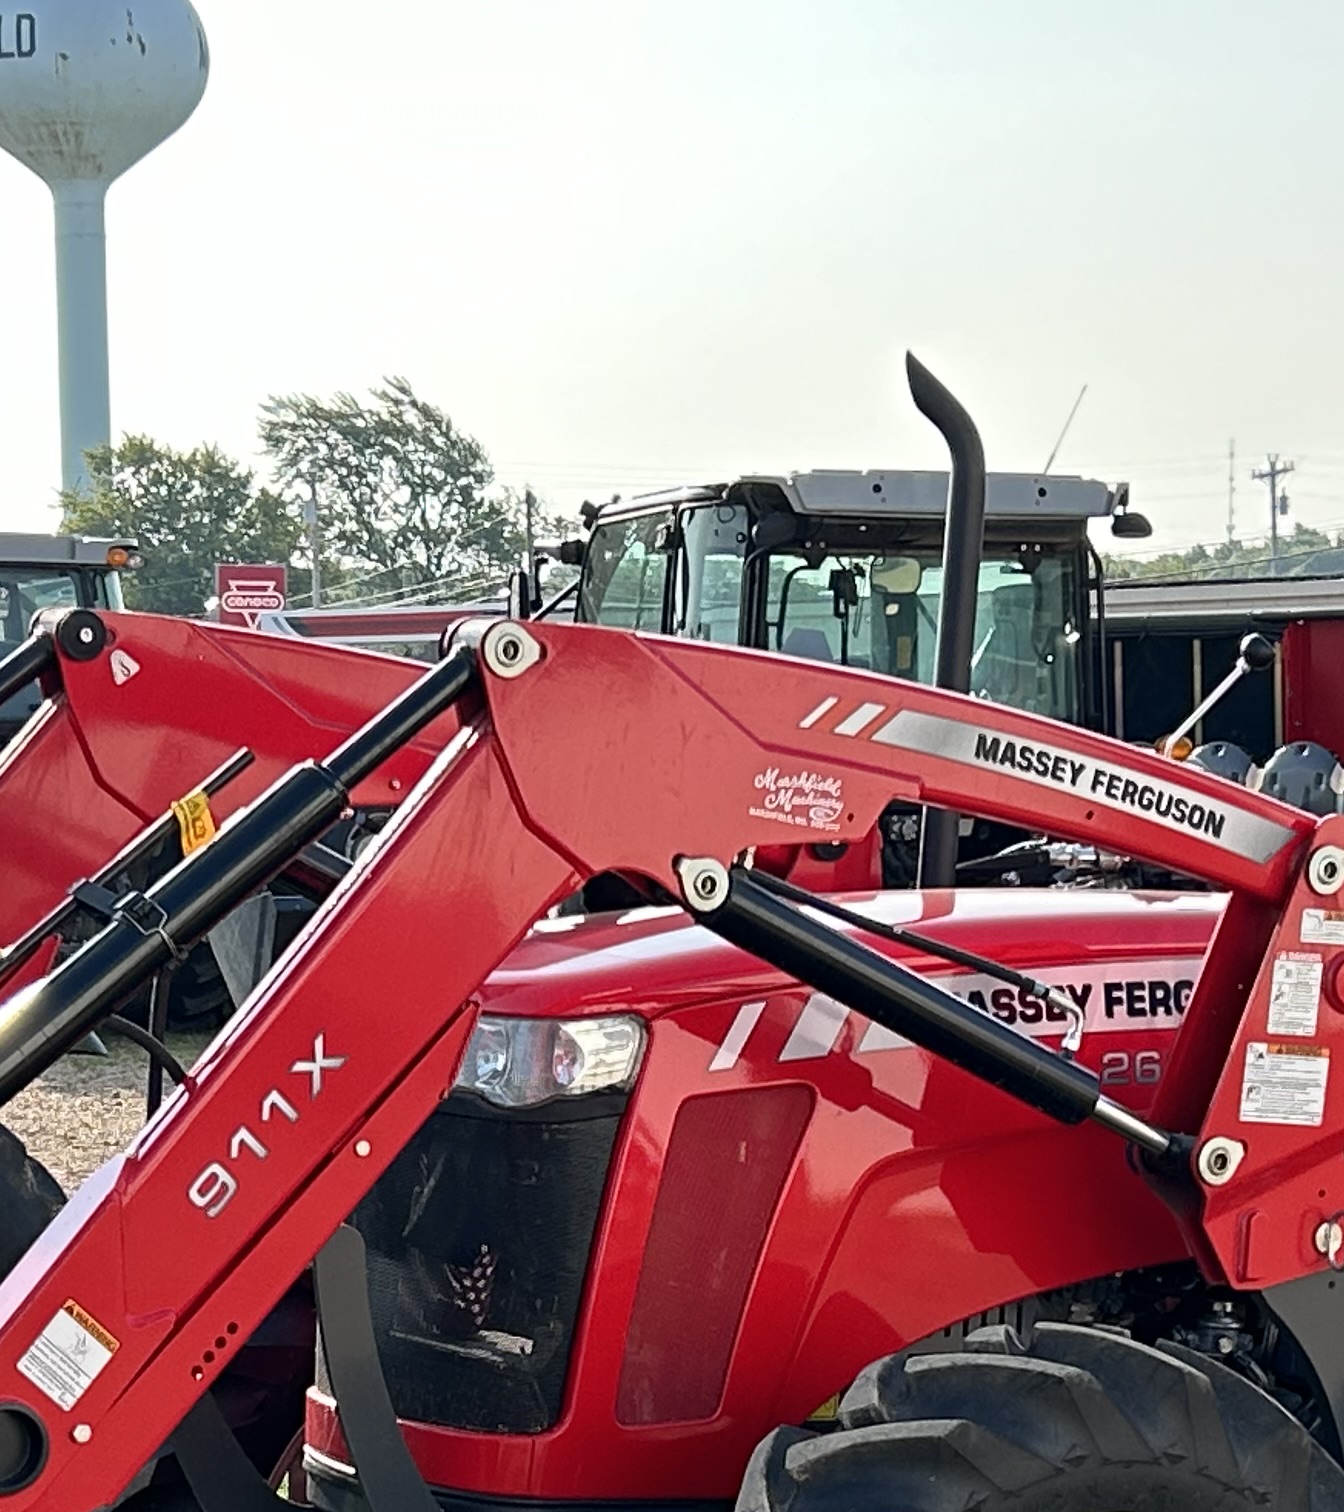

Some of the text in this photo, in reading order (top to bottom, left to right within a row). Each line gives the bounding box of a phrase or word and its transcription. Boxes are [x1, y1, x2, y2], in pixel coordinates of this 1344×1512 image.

[974, 733, 1225, 840] MASSEY FERGUSON
[954, 983, 1092, 1026] ASSEY
[187, 1030, 348, 1219] 911X
